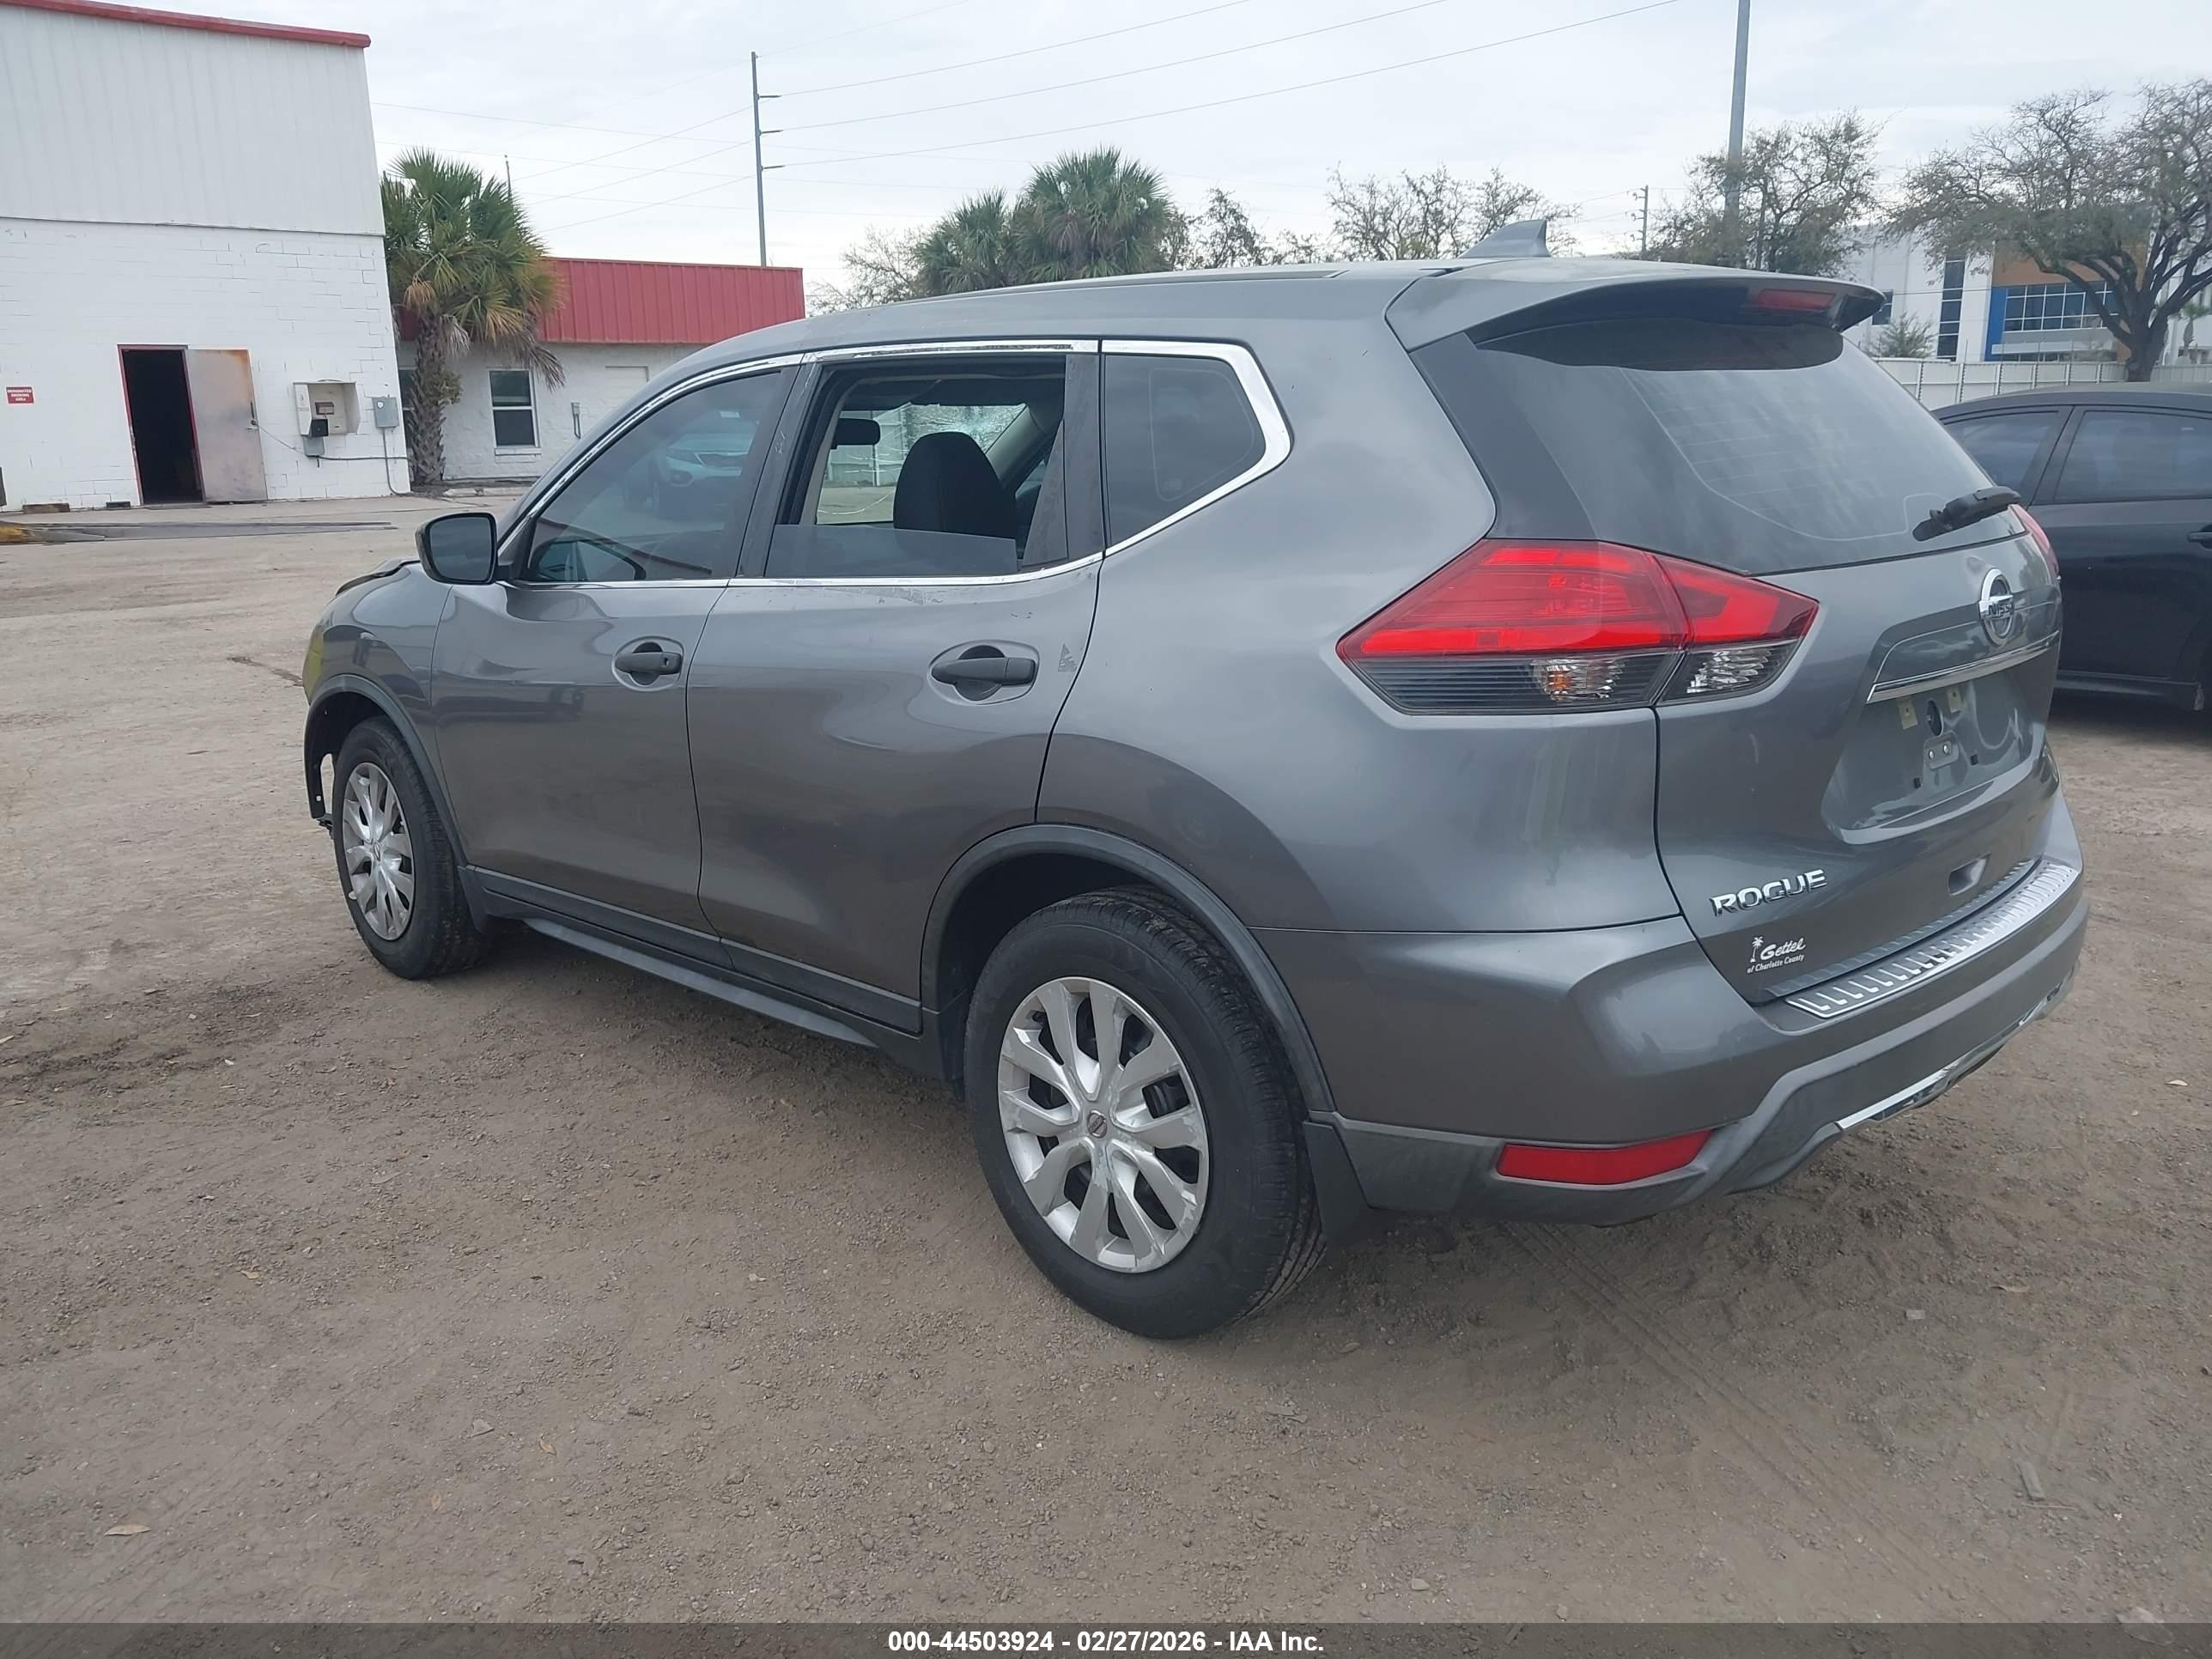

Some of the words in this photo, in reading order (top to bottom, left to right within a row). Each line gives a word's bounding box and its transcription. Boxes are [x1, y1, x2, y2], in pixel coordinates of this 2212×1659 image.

[1710, 869, 1827, 916] ROGUE
[1760, 937, 1807, 960] Gettel
[1747, 965, 1755, 974] of
[1754, 960, 1784, 972] Charlotte
[1784, 954, 1805, 965] County
